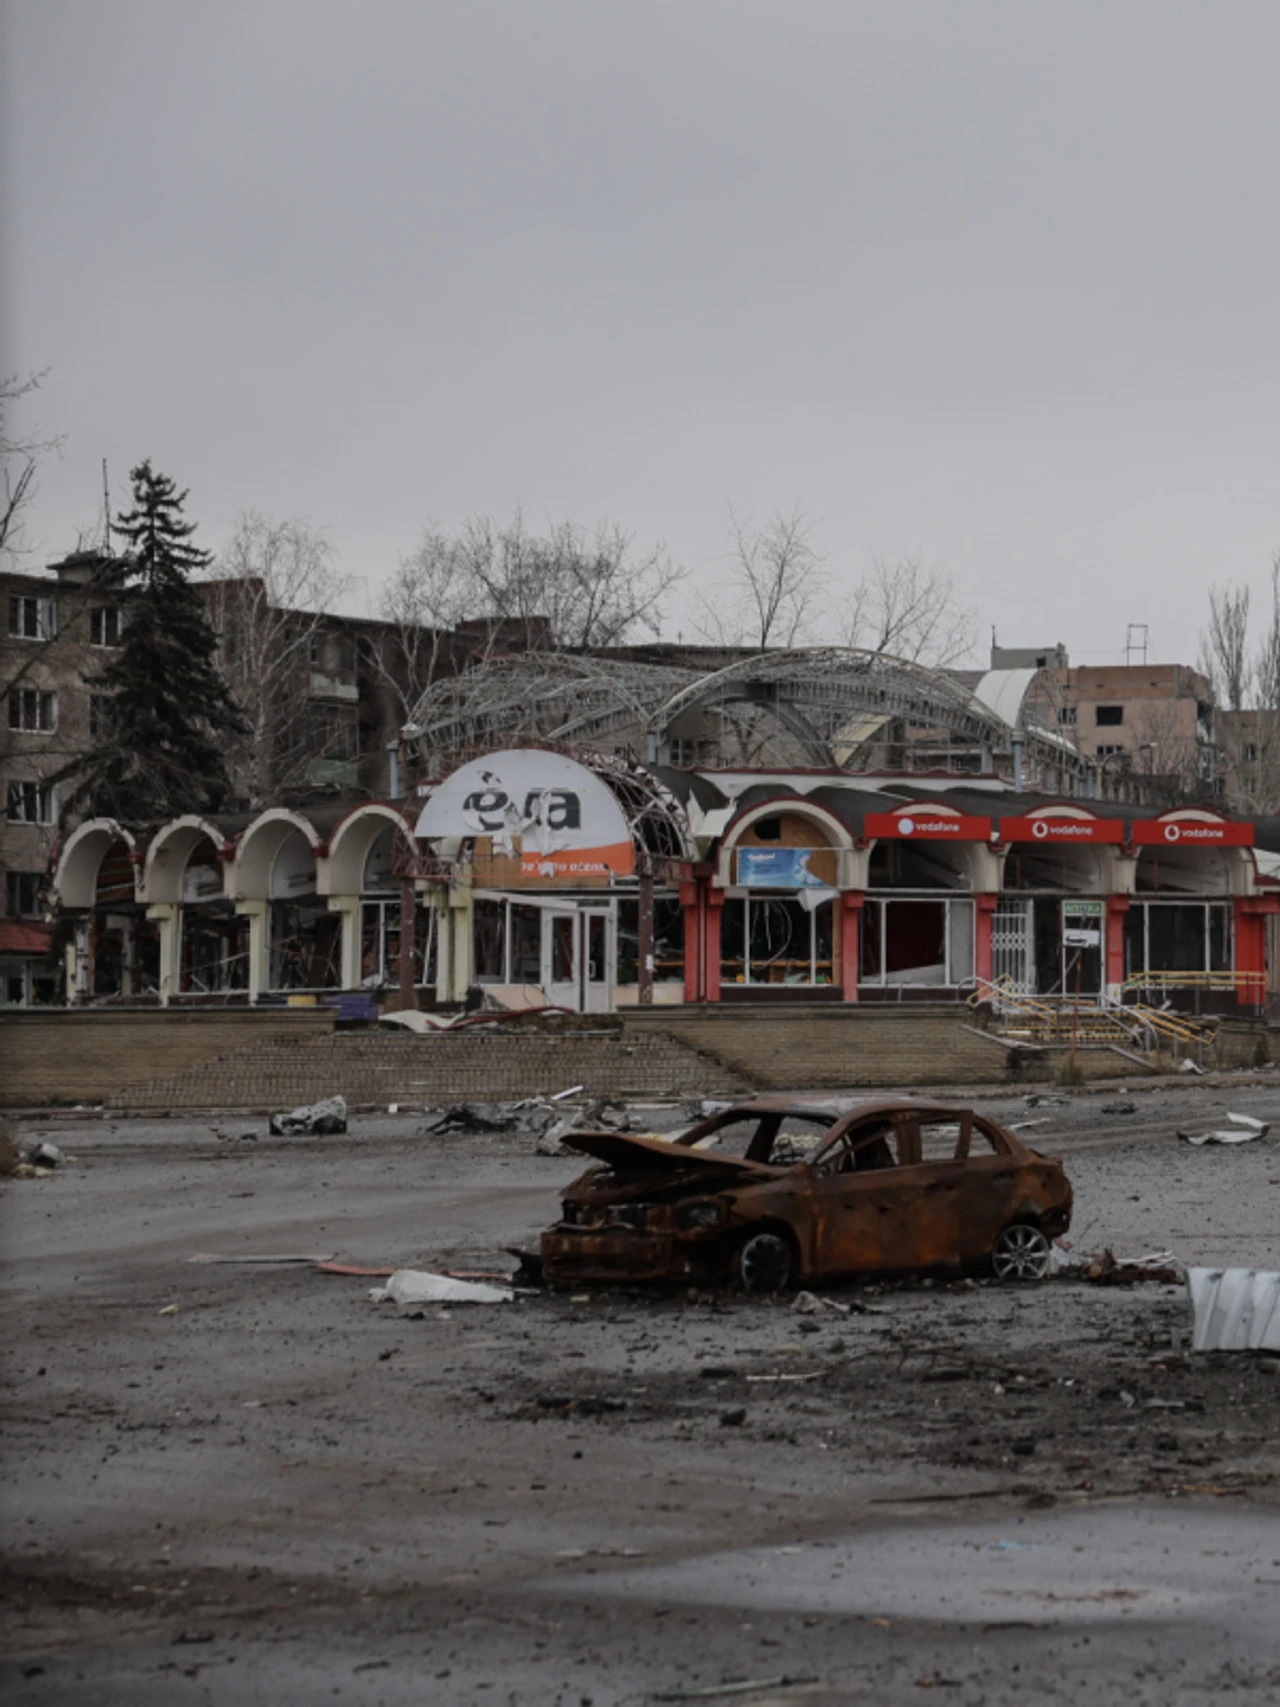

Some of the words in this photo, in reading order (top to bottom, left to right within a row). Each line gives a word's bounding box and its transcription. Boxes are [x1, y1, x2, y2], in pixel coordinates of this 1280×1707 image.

[915, 820, 960, 831] vodafone
[1049, 824, 1093, 835] vodafone
[1181, 827, 1224, 838] vodafone
